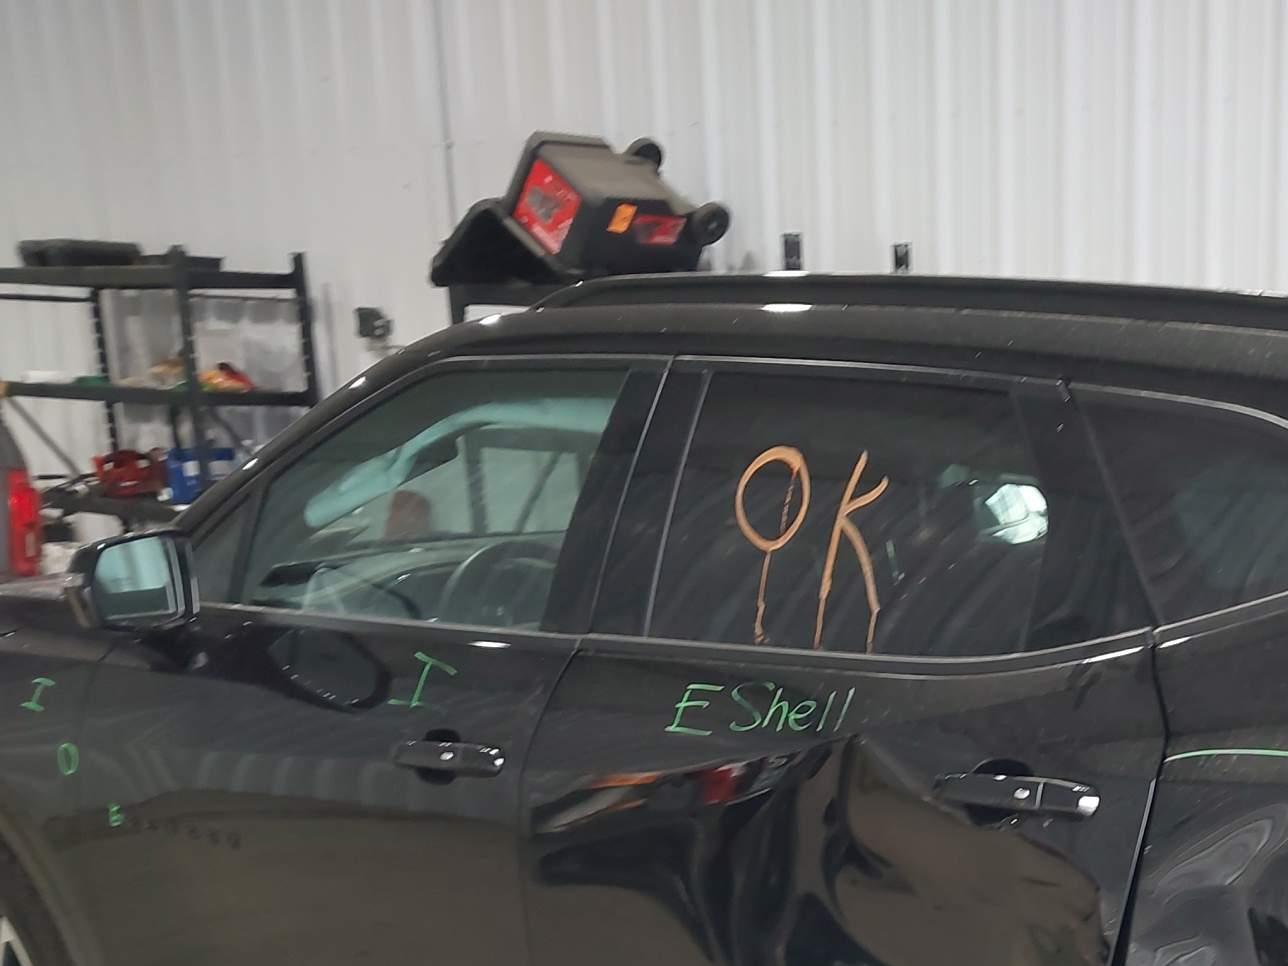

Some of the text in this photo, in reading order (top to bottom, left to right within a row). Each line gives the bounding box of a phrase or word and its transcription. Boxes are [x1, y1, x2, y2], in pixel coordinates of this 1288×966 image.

[734, 444, 890, 654] OK
[664, 681, 856, 736] E Shell
